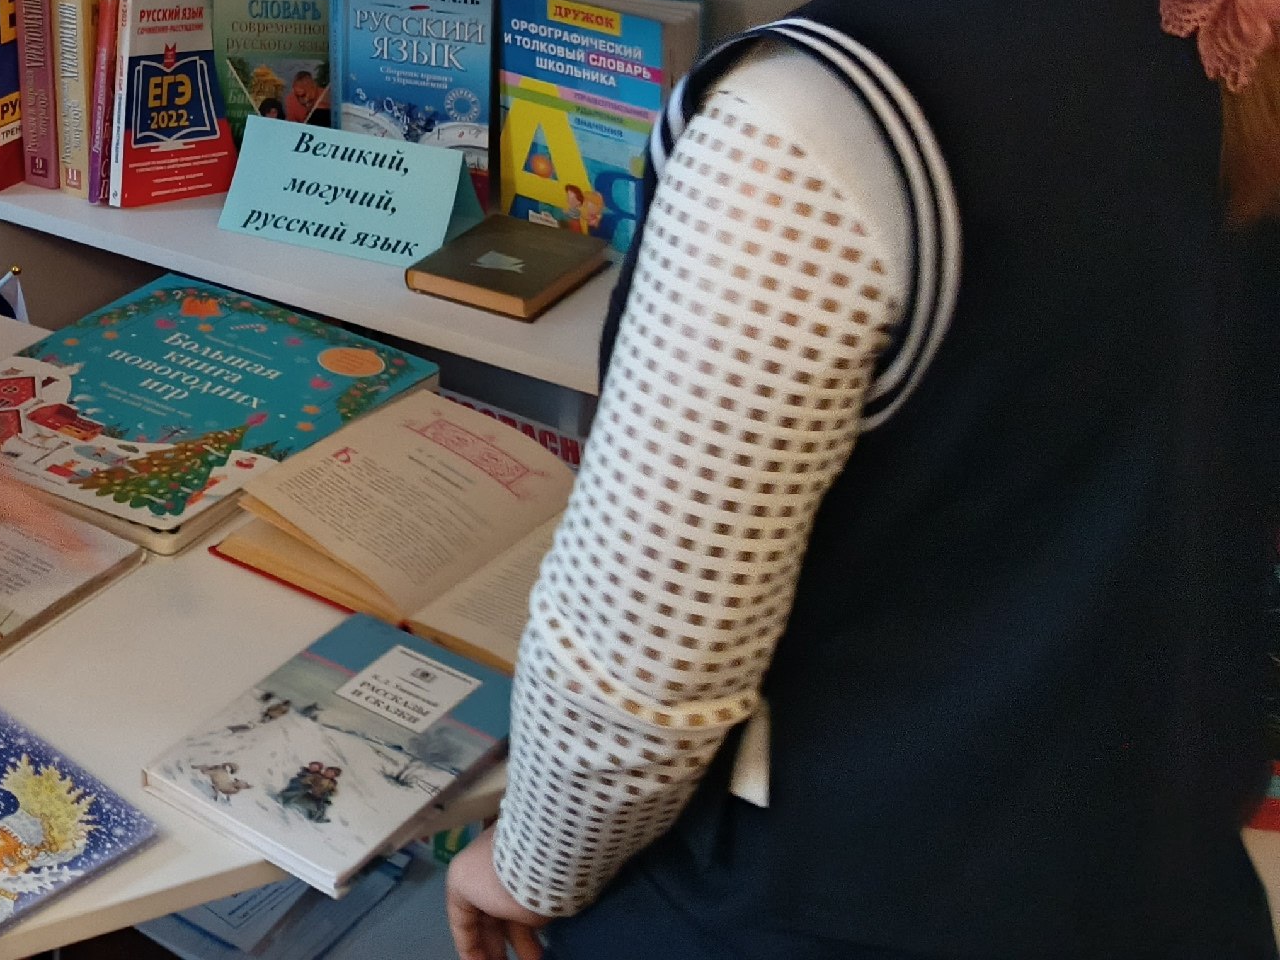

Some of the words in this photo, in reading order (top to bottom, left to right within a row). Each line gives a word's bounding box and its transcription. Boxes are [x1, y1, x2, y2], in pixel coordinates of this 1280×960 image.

[139, 5, 180, 23] РУССКИЙ
[181, 6, 205, 20] ЯЗЫК
[353, 7, 486, 45] РУССКИЙ
[553, 4, 616, 31] ДРУЖОК
[226, 38, 293, 53] русского
[298, 38, 329, 51] язы
[370, 36, 467, 72] ЯЗЫК
[504, 33, 513, 44] И
[514, 34, 586, 63] ТОЛКОВЫЙ
[588, 52, 652, 80] СЛОВАРЬ
[510, 17, 644, 60] ОРФОГРАФИЧЕСКИЙ
[535, 56, 617, 87] ШКОЛЬНИКА
[147, 72, 193, 108] ЕГЭ
[151, 109, 190, 129] 2022
[292, 131, 410, 177] Великий,
[283, 176, 397, 216] могучий,
[241, 208, 347, 243] русский
[349, 232, 419, 258] язык
[163, 332, 283, 380] Большая
[163, 351, 243, 384] книга
[107, 349, 267, 409] новогодних
[139, 377, 189, 401] игр
[359, 681, 431, 717] РАССКАЗЫ
[365, 695, 421, 724] СКАЗКИ
